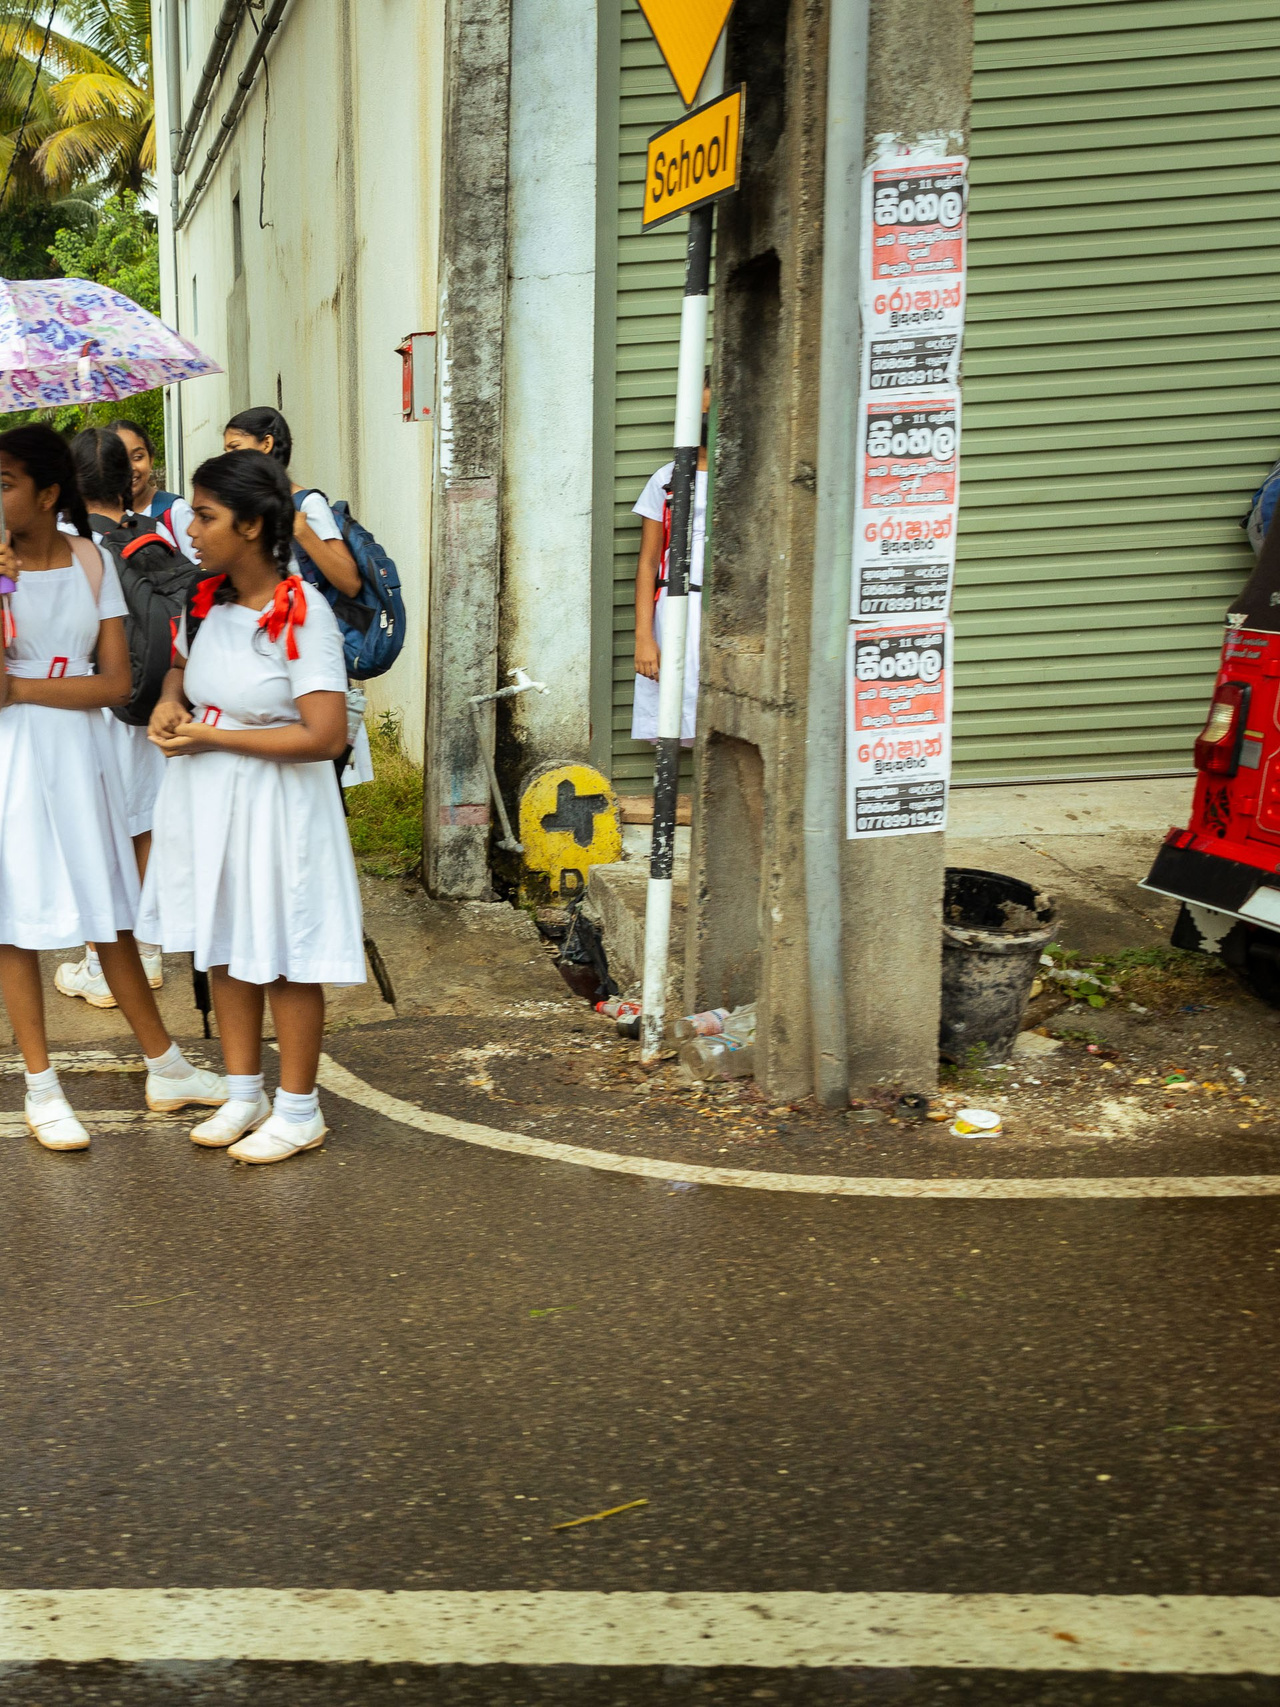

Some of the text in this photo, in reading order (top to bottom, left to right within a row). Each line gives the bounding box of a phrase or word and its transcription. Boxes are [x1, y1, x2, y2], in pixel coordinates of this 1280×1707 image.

[652, 115, 730, 203] School
[918, 179, 933, 190] 11
[874, 187, 962, 227] සිංහල
[912, 414, 927, 424] 11
[867, 420, 956, 461] සිංහල
[898, 638, 913, 648] 11
[856, 645, 942, 682] සිංහල
[857, 811, 943, 830] 0778991942
